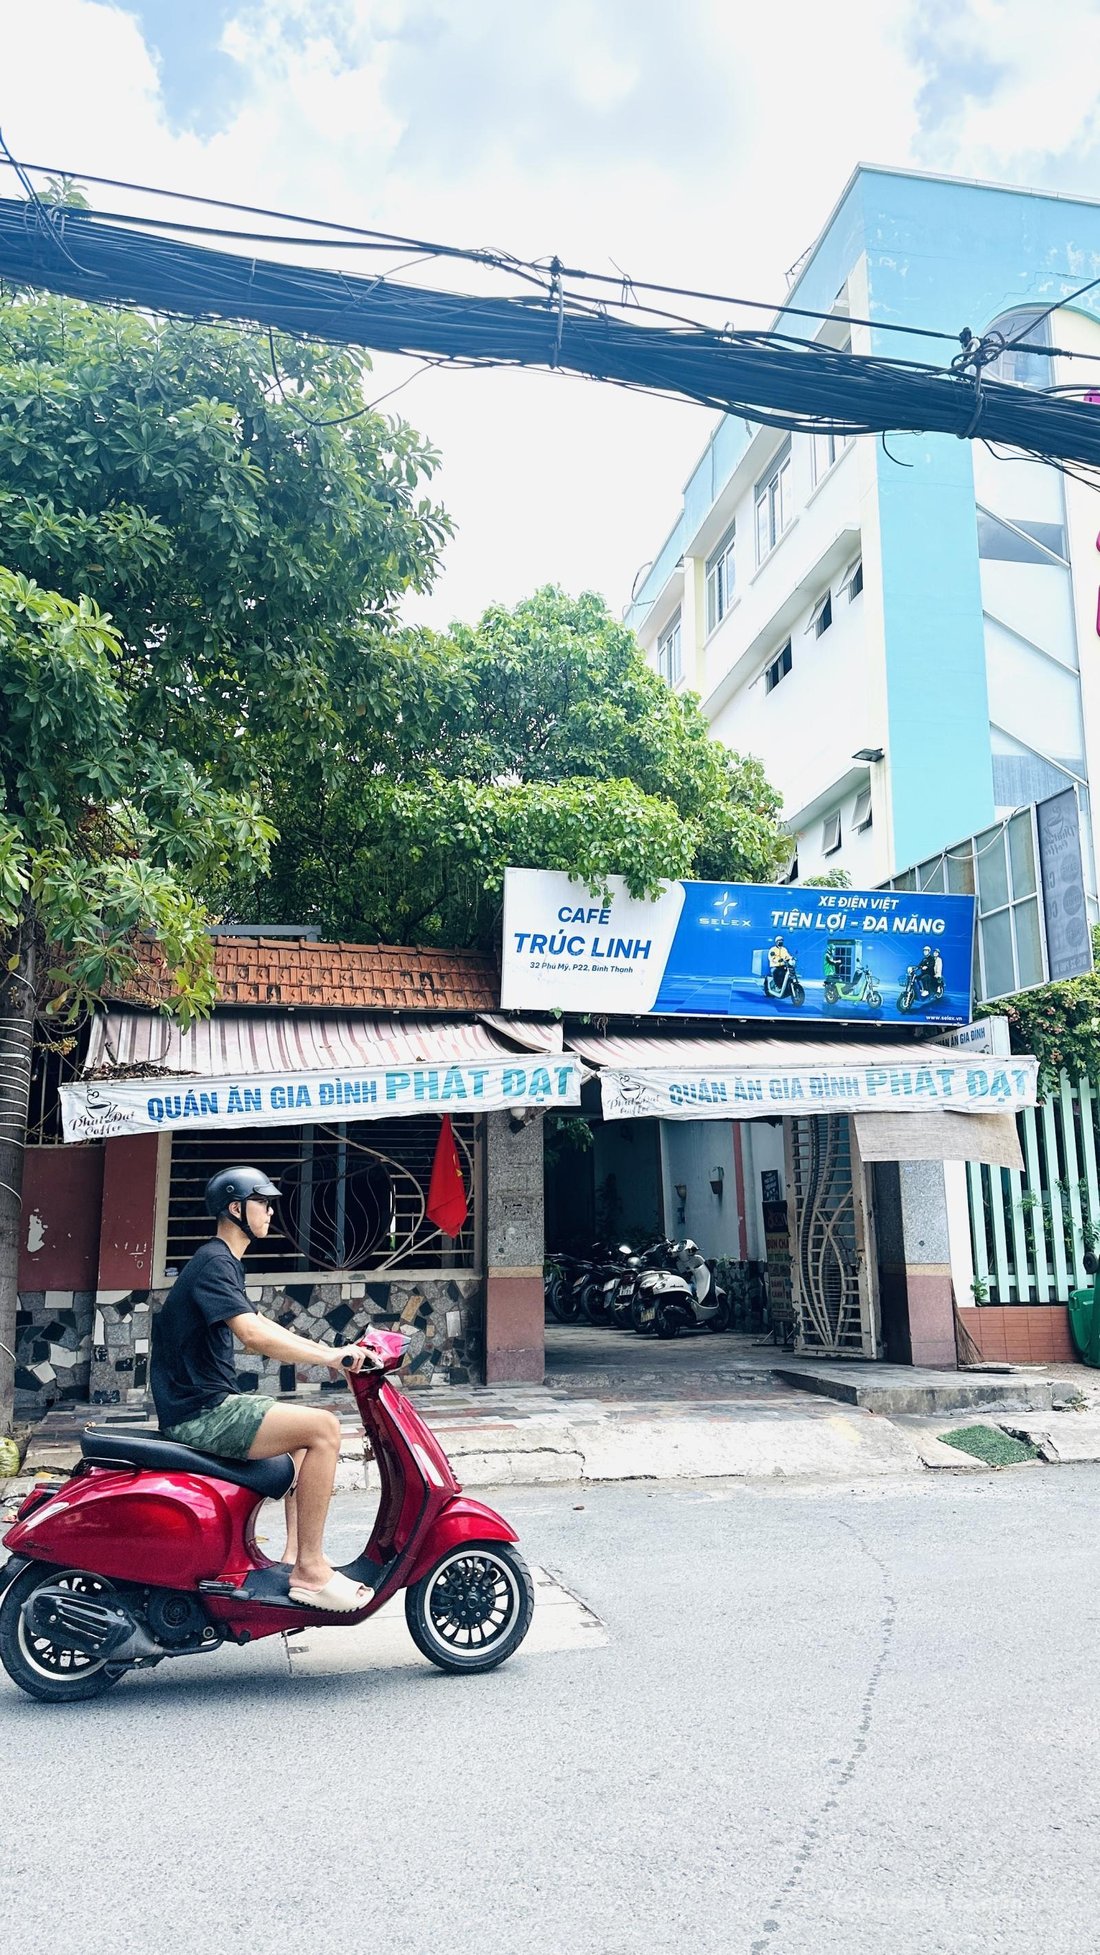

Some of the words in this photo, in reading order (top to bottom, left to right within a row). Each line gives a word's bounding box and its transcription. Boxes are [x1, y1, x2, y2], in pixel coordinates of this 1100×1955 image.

[818, 895, 836, 907] XE
[838, 894, 868, 912] ĐIỆN
[871, 896, 899, 912] VIỆT
[698, 917, 752, 928] SELEX
[771, 908, 813, 933] TIỆN
[815, 911, 847, 934] LỢI
[862, 915, 889, 933] ĐA
[892, 914, 945, 934] NĂNG
[514, 929, 586, 956] TRÚC
[591, 937, 652, 960] LINH
[529, 961, 541, 969] 32
[959, 1031, 970, 1045] GIA
[147, 1088, 219, 1123] QUÁN
[226, 1084, 262, 1114] ĂN
[270, 1084, 312, 1109] GIA
[318, 1077, 377, 1106] ĐÌNH
[385, 1065, 490, 1100] PHÁT
[502, 1066, 574, 1102] ĐẠT
[668, 1078, 728, 1106] QUÁN
[734, 1076, 763, 1101] ĂN
[768, 1077, 804, 1100] GIA
[809, 1073, 860, 1097] ĐÌNH
[966, 1069, 1029, 1102] ĐẠT
